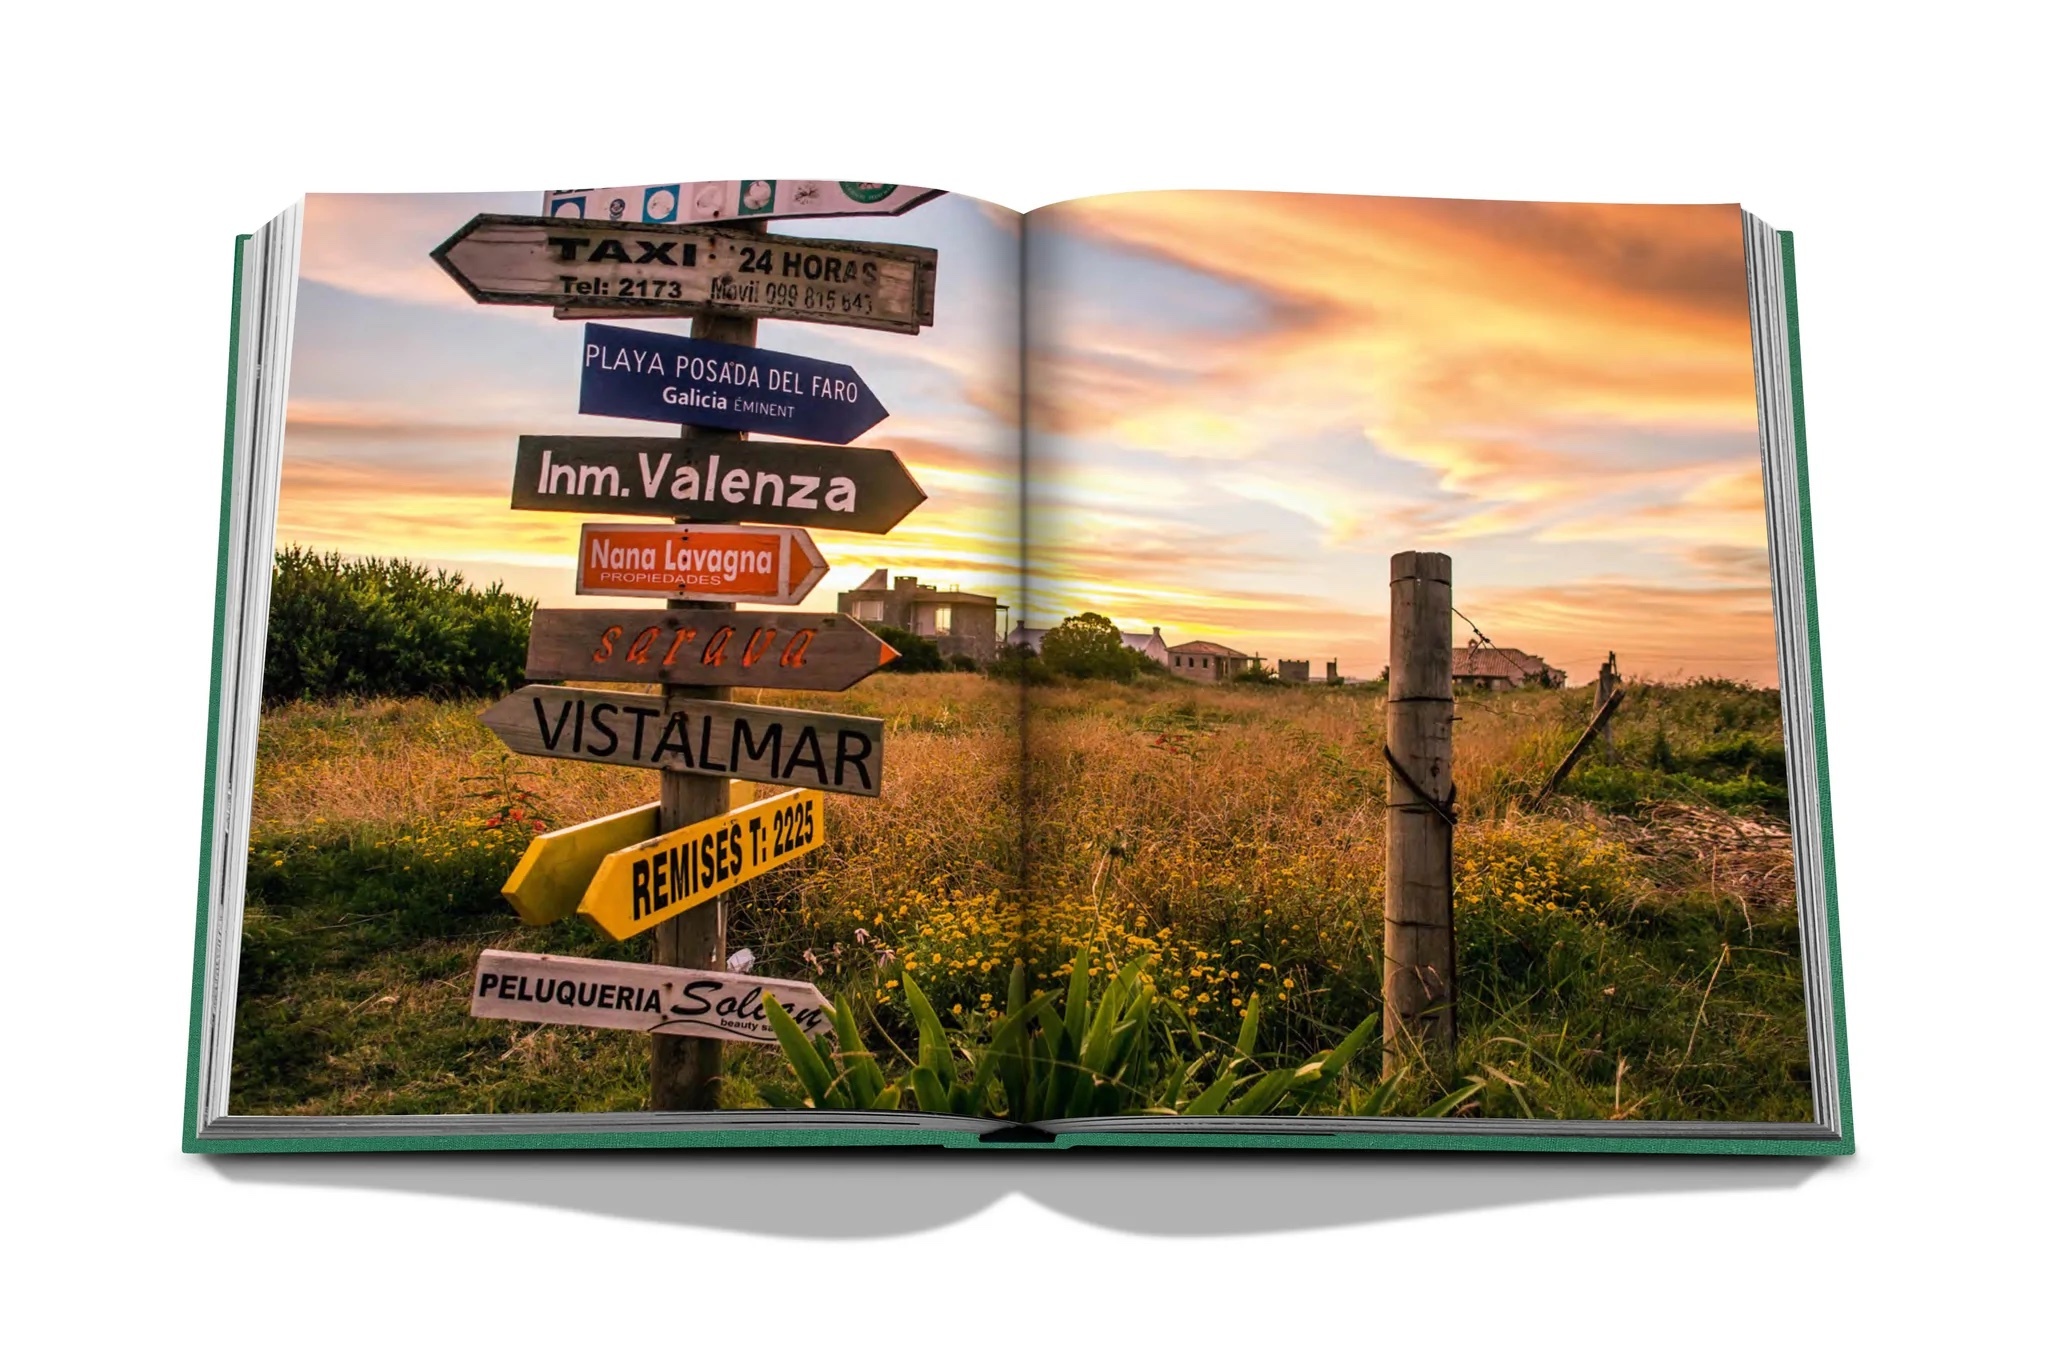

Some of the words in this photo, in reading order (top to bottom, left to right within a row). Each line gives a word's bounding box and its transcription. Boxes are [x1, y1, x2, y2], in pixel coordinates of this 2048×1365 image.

[548, 237, 697, 267] TAXI
[739, 247, 773, 275] 24
[782, 251, 877, 287] HORAS
[560, 276, 609, 296] Tel:
[619, 278, 682, 299] 2173
[586, 344, 665, 376] PLAYA
[676, 355, 760, 388] POSADA
[769, 368, 803, 395] DEL
[812, 375, 858, 403] FARO
[662, 386, 727, 410] Galicia
[734, 396, 795, 418] ÉMINENT
[537, 450, 630, 497] Inm.
[638, 453, 857, 513] Valenza
[591, 538, 656, 570] Nana
[664, 539, 772, 582] Lavagna
[600, 572, 721, 585] PROPIEDADES
[591, 624, 819, 669] sarava
[533, 697, 872, 790] VISTALMAR
[632, 823, 743, 921] REMISES
[749, 817, 767, 867] T:
[773, 800, 813, 858] 2225
[479, 973, 661, 1013] PELUQUERIA
[720, 1018, 758, 1031] beauty
